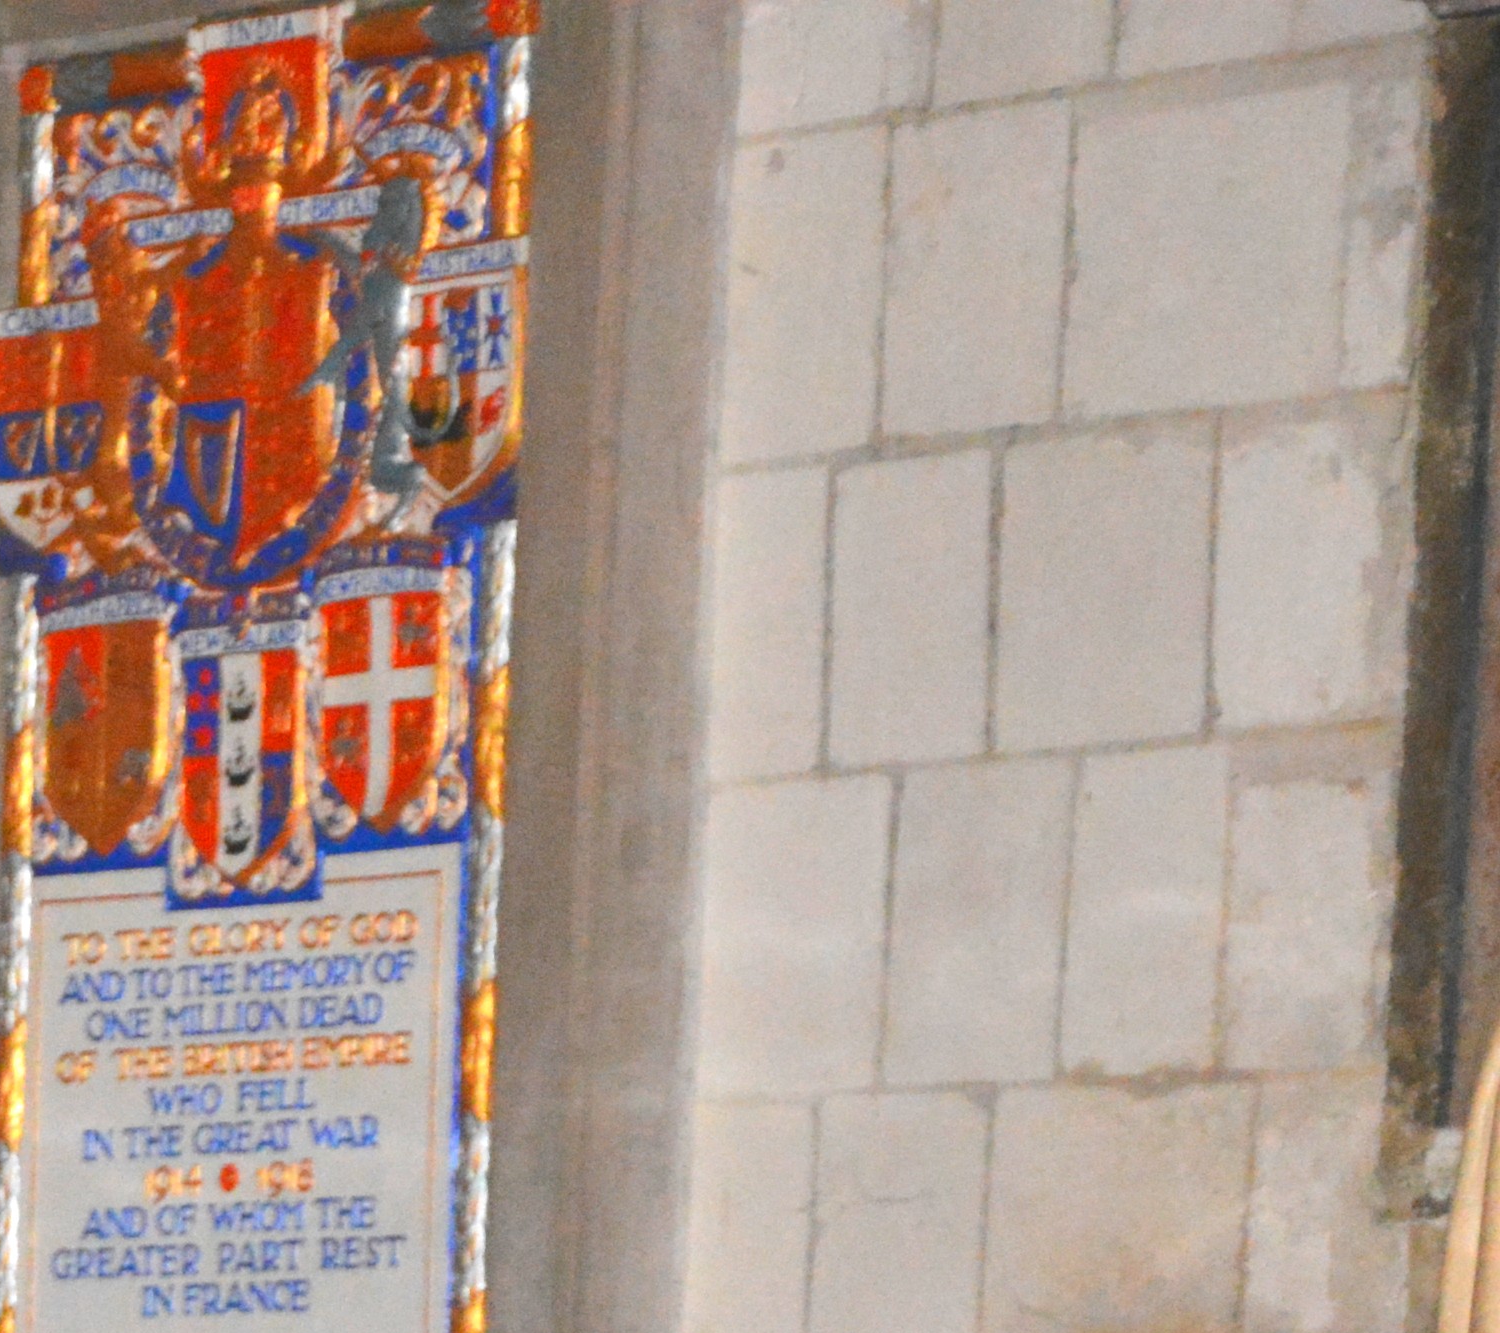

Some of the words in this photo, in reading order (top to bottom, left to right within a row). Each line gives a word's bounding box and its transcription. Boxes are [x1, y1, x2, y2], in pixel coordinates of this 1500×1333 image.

[62, 933, 106, 967] TO
[115, 928, 174, 962] THE
[189, 920, 288, 958] GLORY
[301, 915, 340, 948] OF
[350, 910, 418, 945] GOD
[61, 969, 125, 1004] AND
[134, 967, 172, 999] TO
[180, 963, 235, 997] THE
[245, 956, 366, 994] MEMORY
[375, 950, 415, 983] OF
[87, 1007, 150, 1042] ONE
[162, 999, 288, 1038] MILLION
[301, 994, 382, 1030] DEAD
[56, 1051, 96, 1084] OF
[114, 1046, 171, 1080] THE
[183, 1038, 294, 1077] BRITISH
[303, 1032, 412, 1071] EMPIRE
[149, 1084, 222, 1115] WHO
[237, 1080, 313, 1112] FELL
[83, 1130, 113, 1161] IN
[124, 1125, 180, 1159] THE
[193, 1120, 291, 1155] GREAT
[309, 1116, 378, 1150] WAR
[145, 1164, 202, 1202] 1914
[83, 1205, 146, 1240] AND
[157, 1204, 195, 1236] OF
[209, 1199, 302, 1234] WHOM
[318, 1196, 376, 1229] THE
[52, 1244, 198, 1280] GREATER
[218, 1241, 304, 1274] PART
[320, 1236, 406, 1270] REST
[142, 1285, 173, 1318] IN
[183, 1279, 310, 1315] FRANCE
